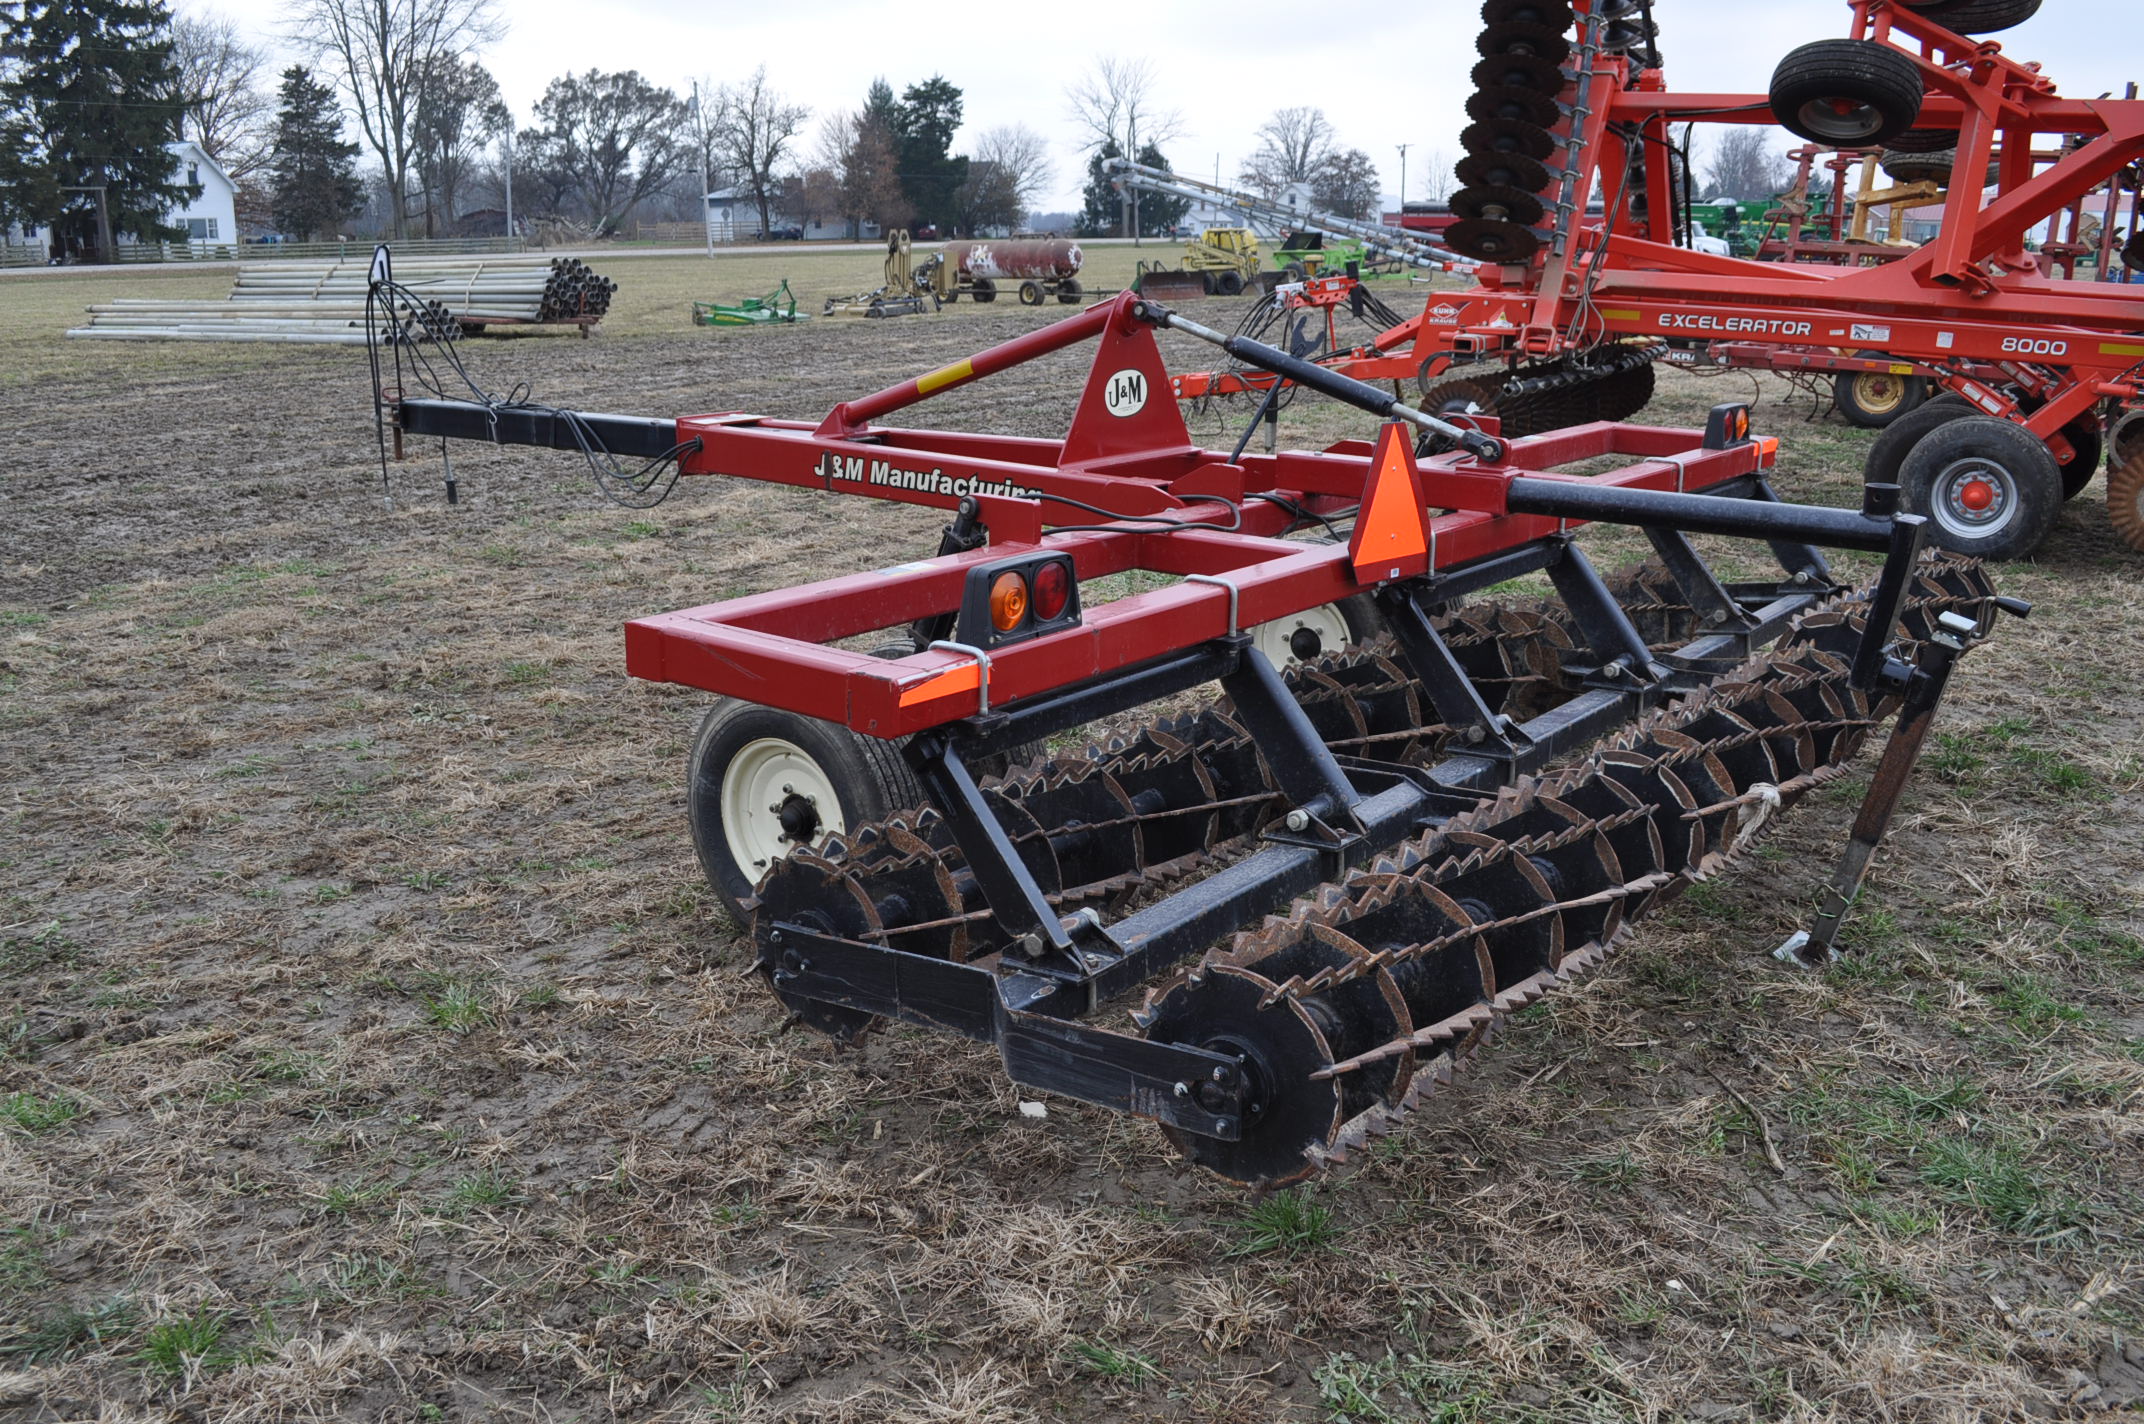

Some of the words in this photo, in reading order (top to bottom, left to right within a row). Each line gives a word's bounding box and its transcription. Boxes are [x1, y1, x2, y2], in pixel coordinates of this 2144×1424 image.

[1429, 316, 1457, 326] KRAUSE
[1432, 307, 1455, 315] KUHN
[1658, 313, 1812, 336] EXCELERATOR
[2001, 337, 2067, 356] 8000
[1108, 374, 1142, 408] J&M
[814, 453, 864, 482] J&M
